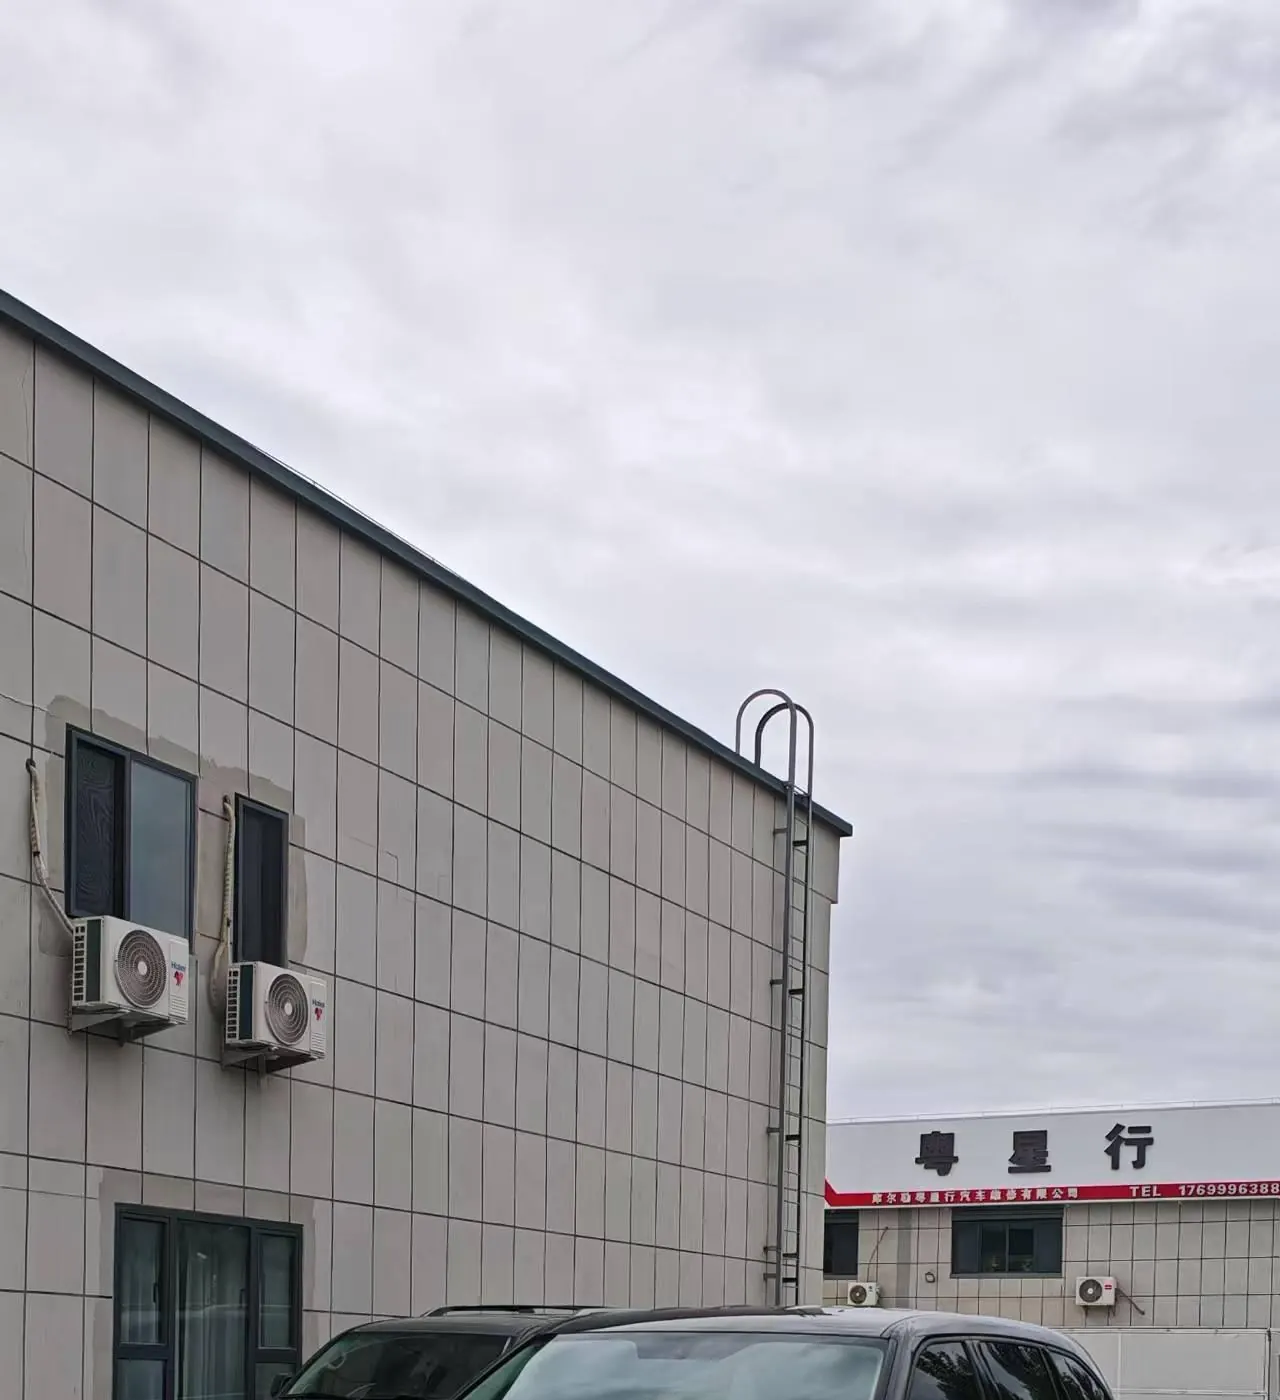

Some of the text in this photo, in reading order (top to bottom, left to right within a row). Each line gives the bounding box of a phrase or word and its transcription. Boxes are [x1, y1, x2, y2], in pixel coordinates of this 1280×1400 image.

[914, 1123, 1154, 1177] 粤星行
[1129, 1183, 1280, 1197] TEL 1769996388
